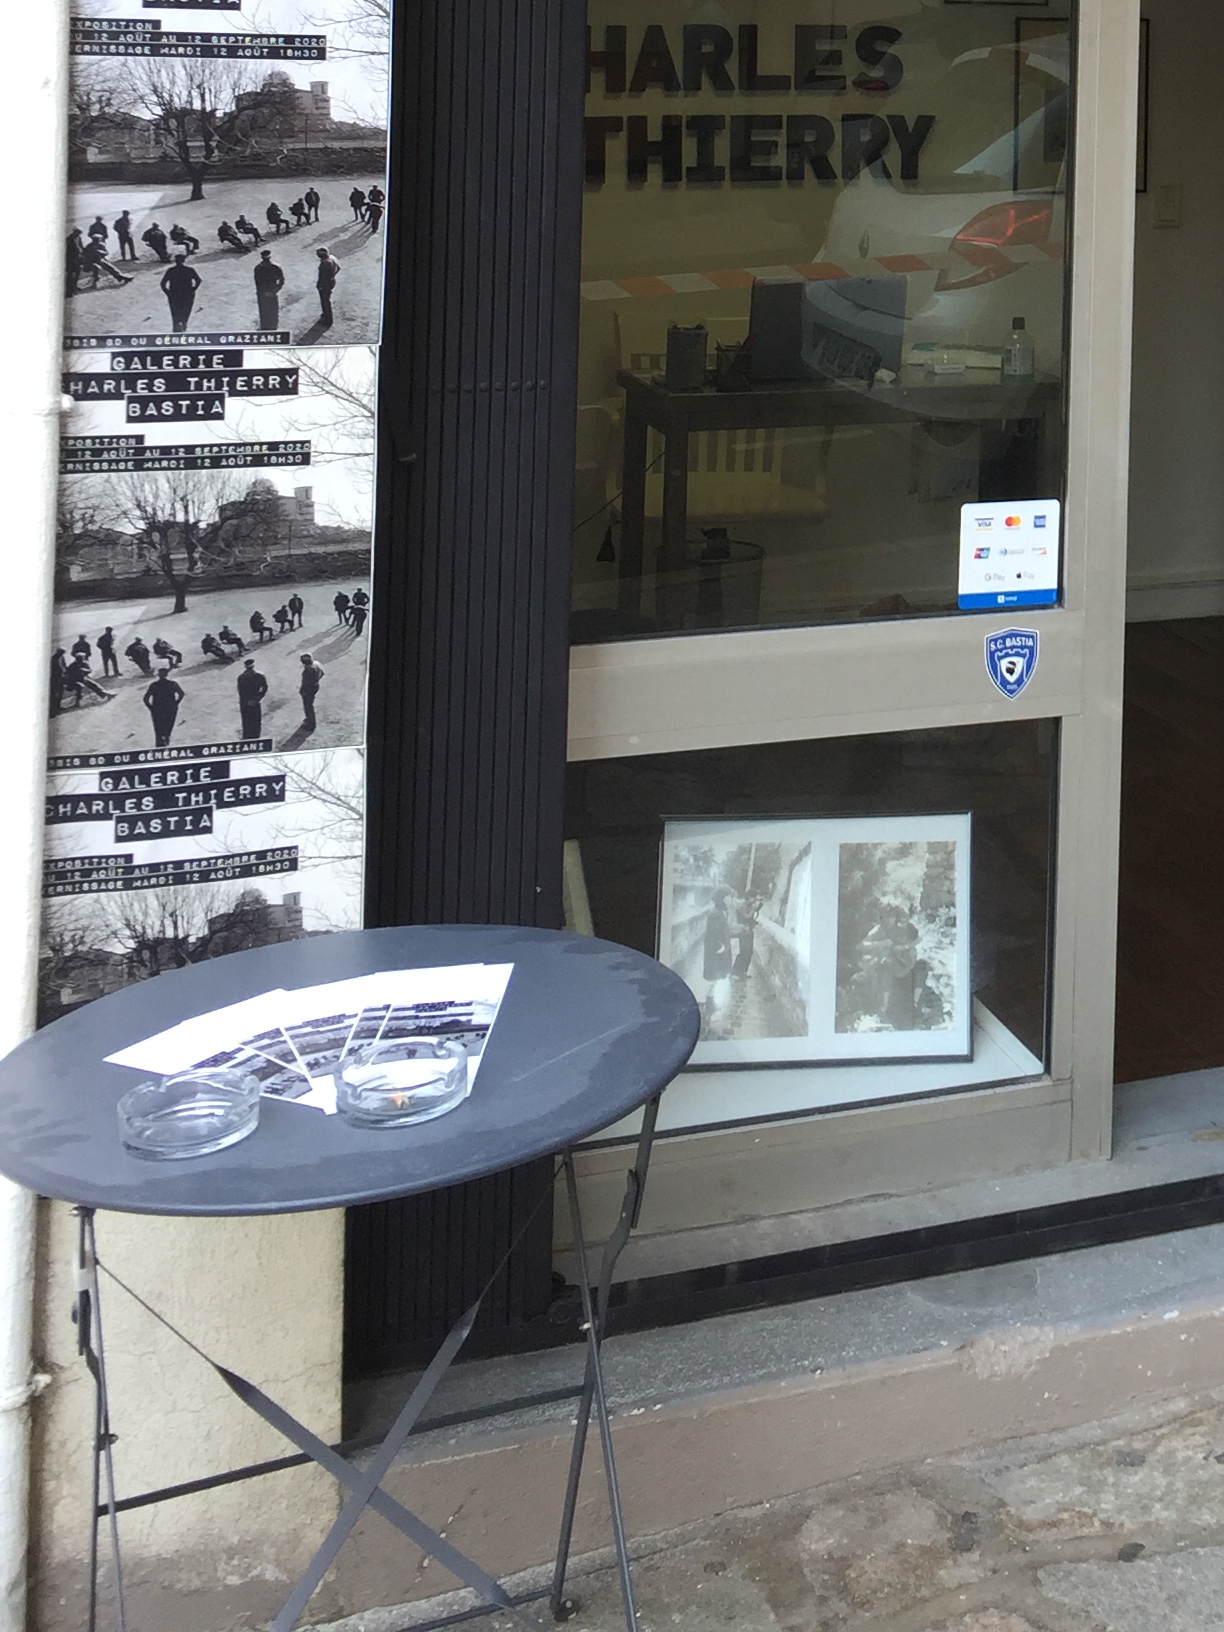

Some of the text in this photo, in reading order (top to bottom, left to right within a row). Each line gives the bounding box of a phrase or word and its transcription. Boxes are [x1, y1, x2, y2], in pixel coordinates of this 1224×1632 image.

[94, 32, 108, 42] 12
[161, 34, 177, 43] AU
[187, 35, 202, 44] 12
[211, 35, 285, 46] SEPTEMBRE
[70, 44, 318, 57] ERNISSAGE MARDI 12 AOÛT 18H30
[586, 24, 904, 94] HARLES
[131, 337, 147, 346] DU
[155, 334, 211, 346] GÉNÉRAL
[219, 334, 282, 344] GRAZIANI
[113, 354, 224, 370] GALERIE
[64, 374, 297, 395] HARLES THIERRY
[128, 400, 223, 416] BASTIA
[63, 437, 136, 447] POSITION
[77, 450, 92, 459] 12
[144, 448, 160, 457] AU
[170, 447, 186, 456] 12
[195, 444, 269, 455] SEPTEMBRE
[143, 459, 185, 469] MARDI
[196, 458, 211, 467] 12
[220, 455, 253, 466] AOÛT
[263, 454, 302, 464] 18H30
[1005, 636, 1034, 648] BASTIA
[114, 754, 130, 764] DU
[138, 749, 194, 762] GÉNÉRAL
[202, 742, 264, 756] GRAZIANI
[101, 767, 211, 791] GALERIE
[175, 781, 283, 806] THIERRY
[117, 813, 211, 836] BASTIA
[66, 871, 81, 881] 12
[133, 866, 149, 877] AU
[183, 854, 257, 871] SEPTEMBRE
[42, 861, 290, 896] ERNISSAGE MARDI 12 AOÛT 18H30
